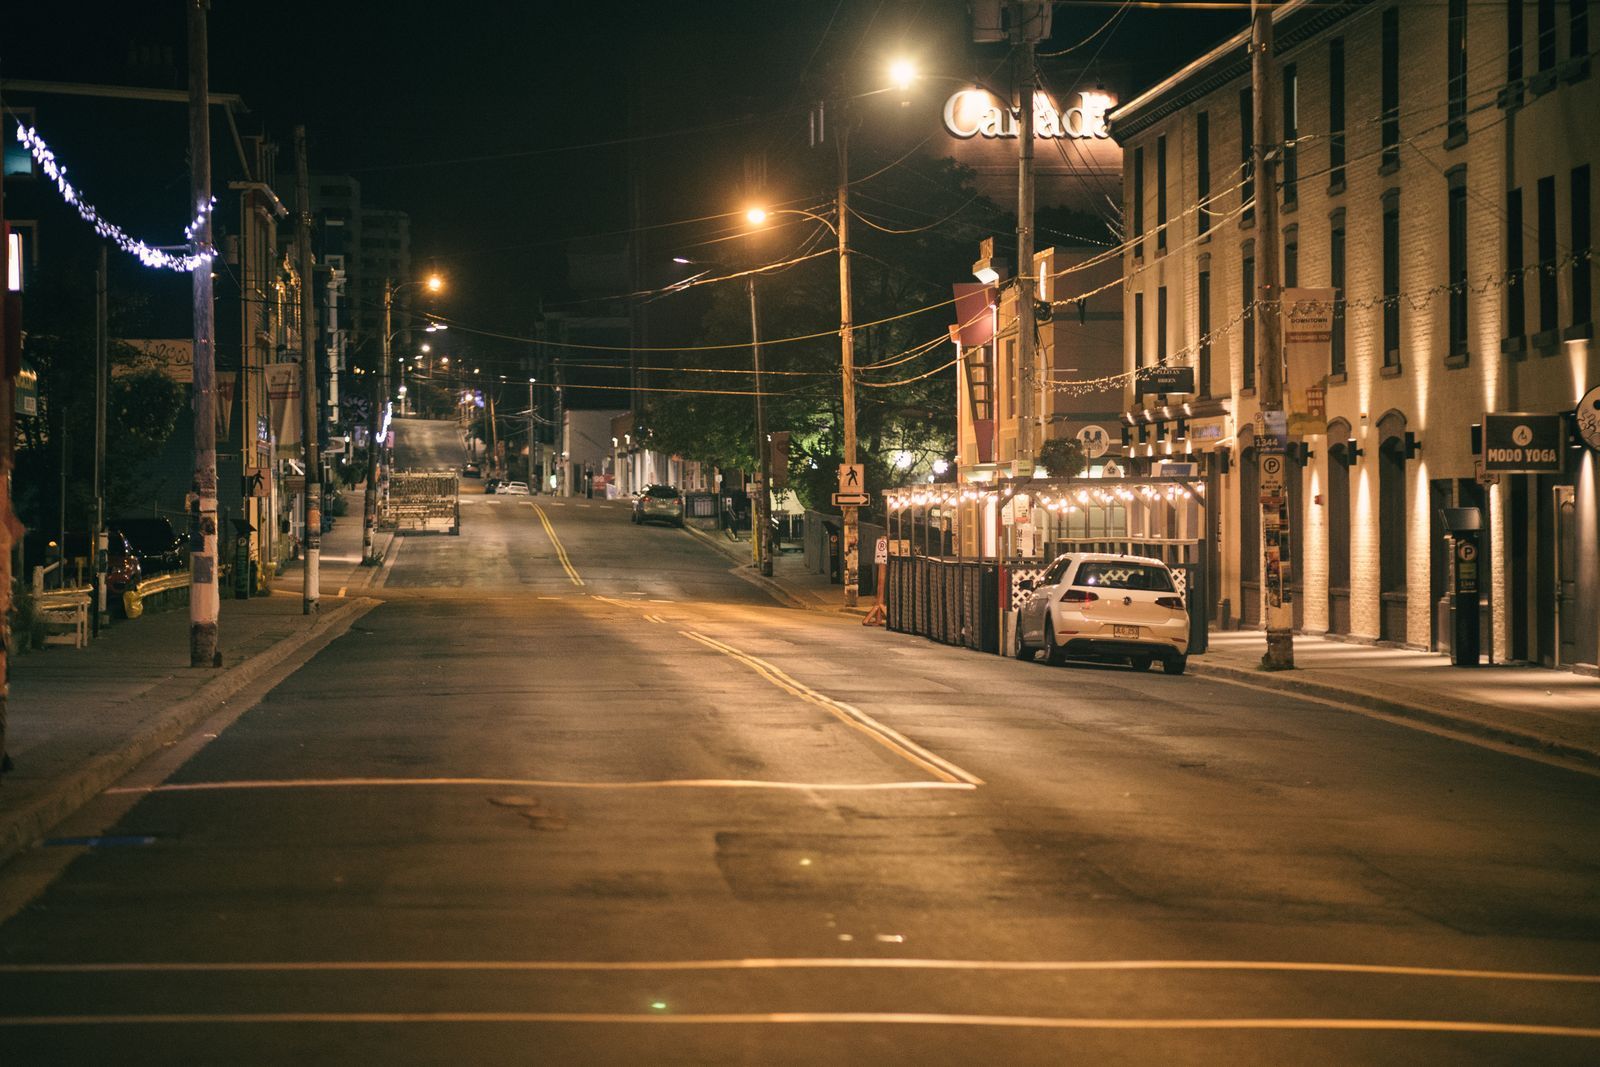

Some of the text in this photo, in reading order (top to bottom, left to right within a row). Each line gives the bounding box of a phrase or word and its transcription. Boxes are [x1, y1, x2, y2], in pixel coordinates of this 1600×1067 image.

[1256, 438, 1278, 447] 1344
[1488, 448, 1557, 462] MODO YOGA
